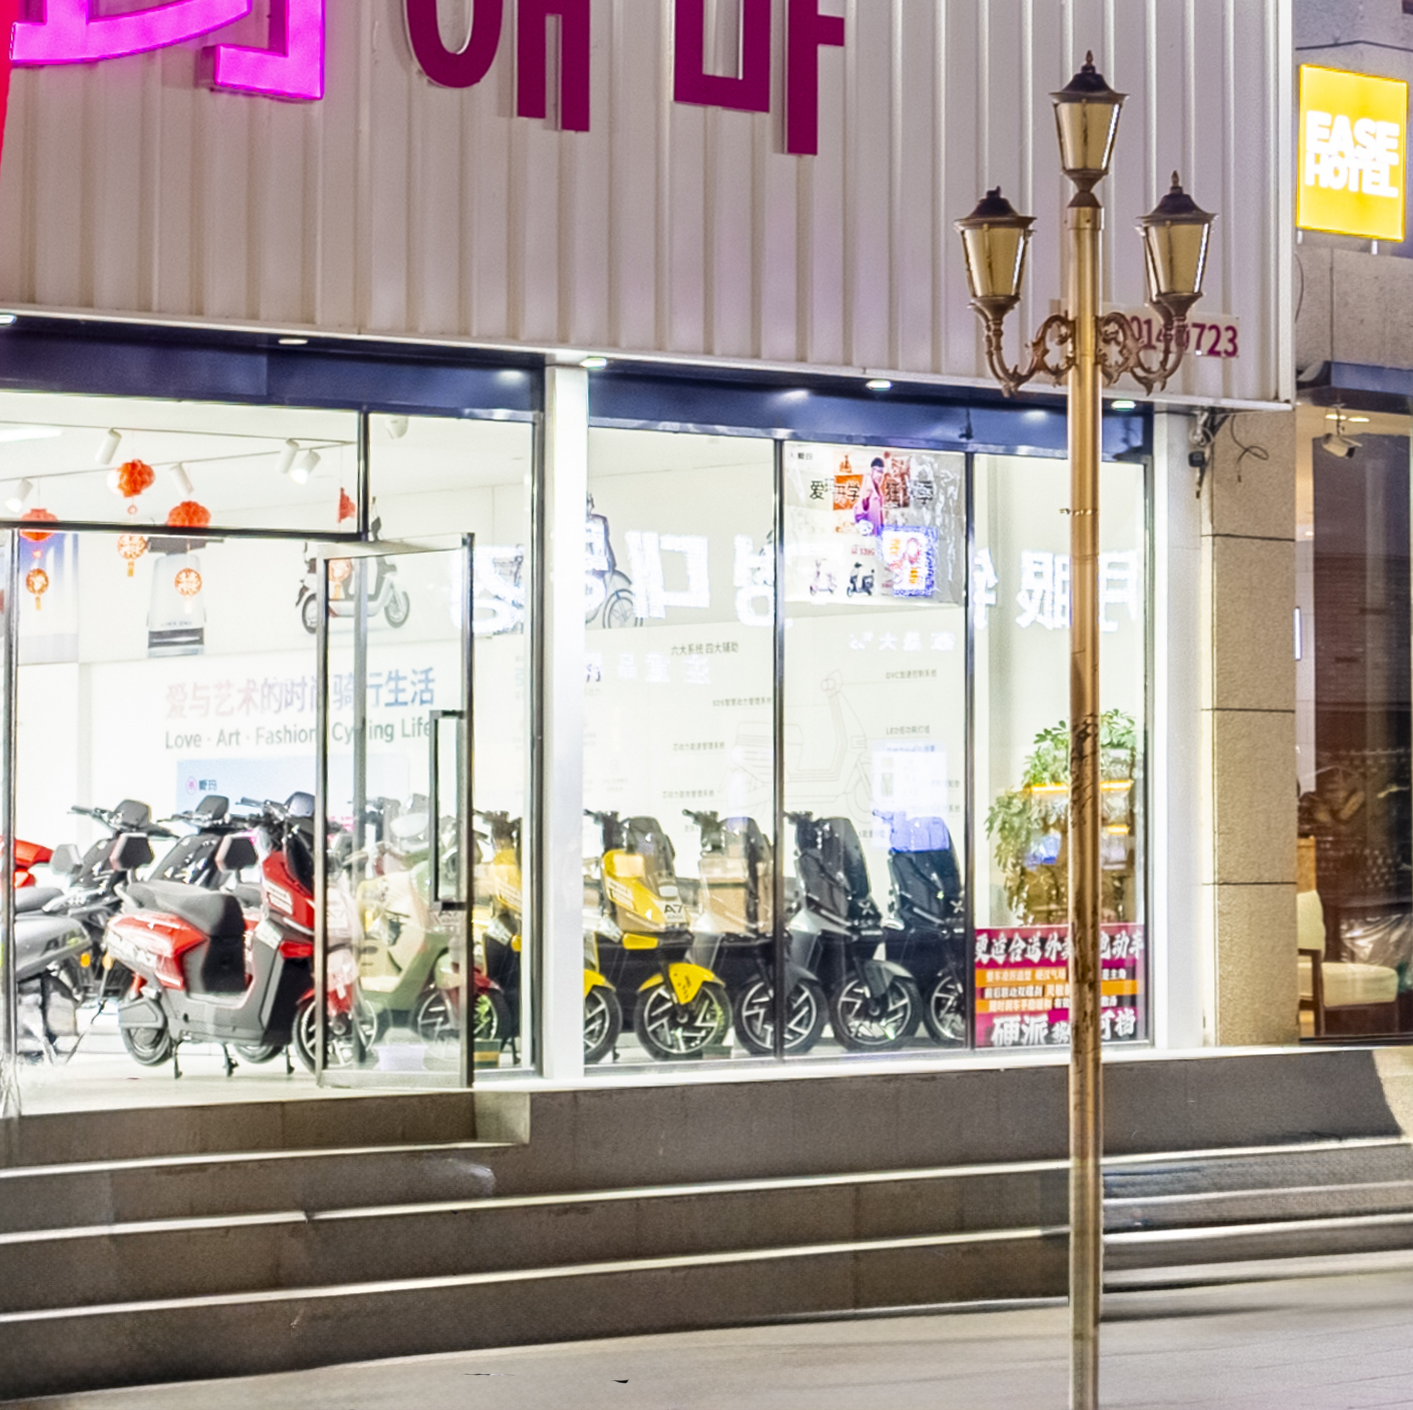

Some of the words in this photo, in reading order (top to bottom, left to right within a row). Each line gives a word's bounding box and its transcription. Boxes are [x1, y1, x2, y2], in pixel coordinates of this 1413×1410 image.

[1305, 110, 1400, 165] EASE
[1304, 150, 1399, 198] HOTEL
[165, 731, 203, 750] Love
[216, 729, 241, 748] Art
[331, 719, 395, 744] Cying
